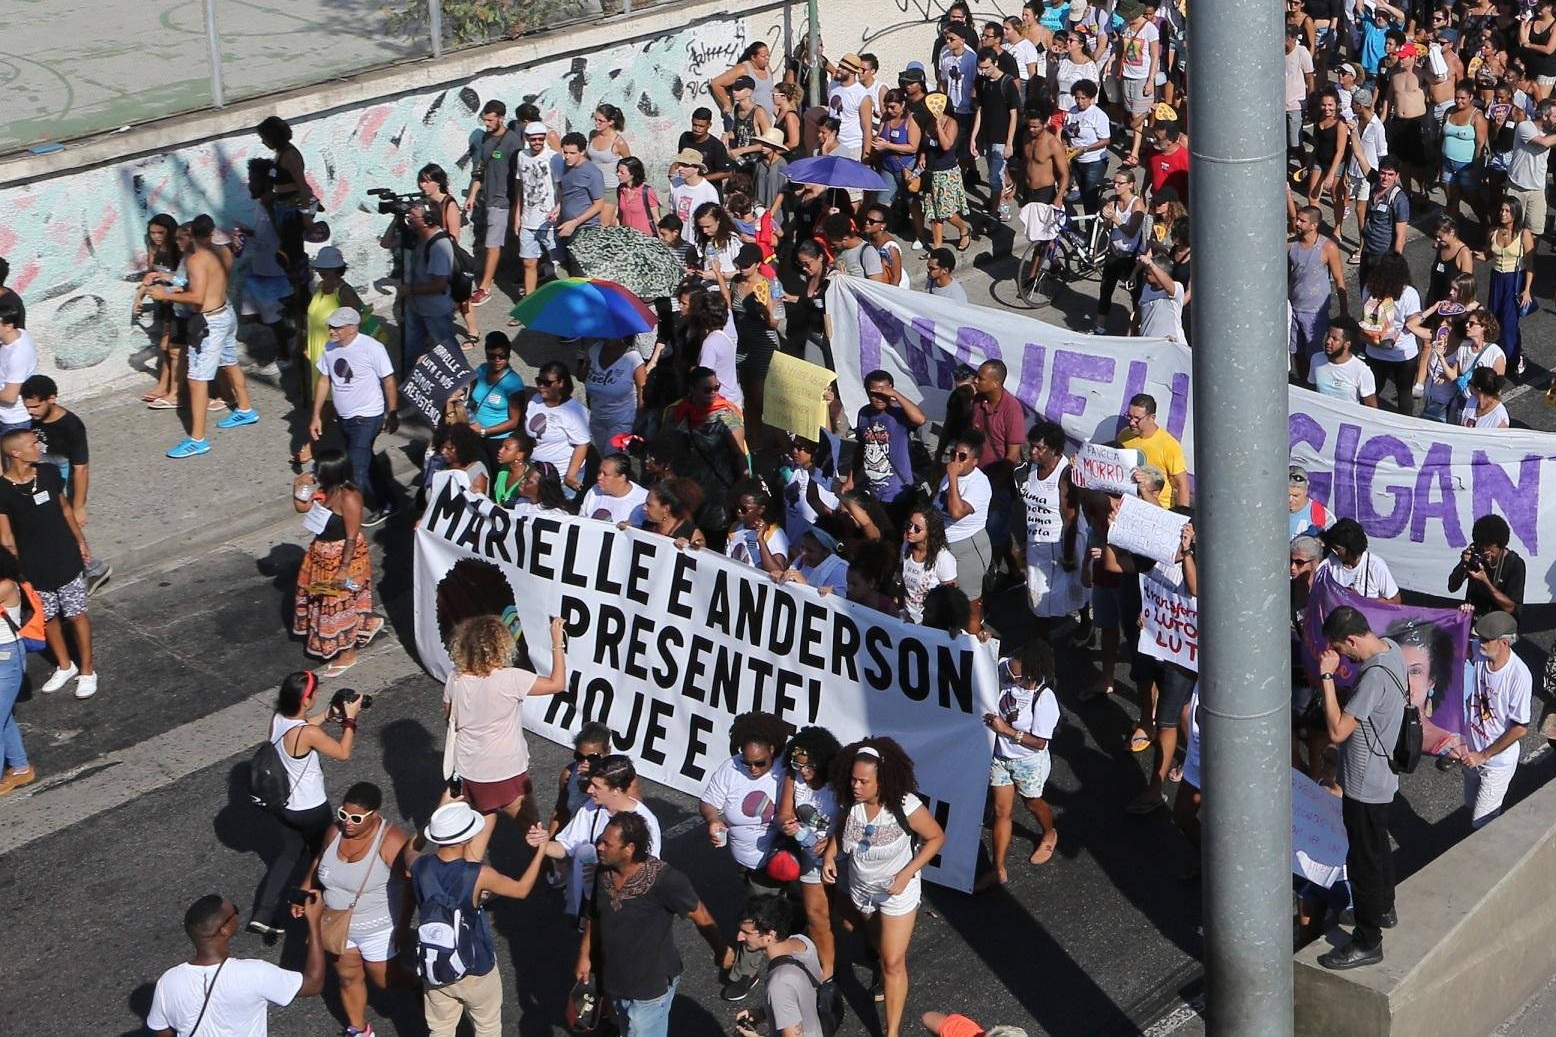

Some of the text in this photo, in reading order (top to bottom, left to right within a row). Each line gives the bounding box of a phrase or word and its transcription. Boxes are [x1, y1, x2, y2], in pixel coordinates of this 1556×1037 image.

[1083, 457, 1124, 483] MORRO
[427, 486, 658, 607] MARIELLE
[707, 570, 974, 714] ANDERSON
[1154, 608, 1198, 639] LUTO
[544, 667, 675, 766] HOJE
